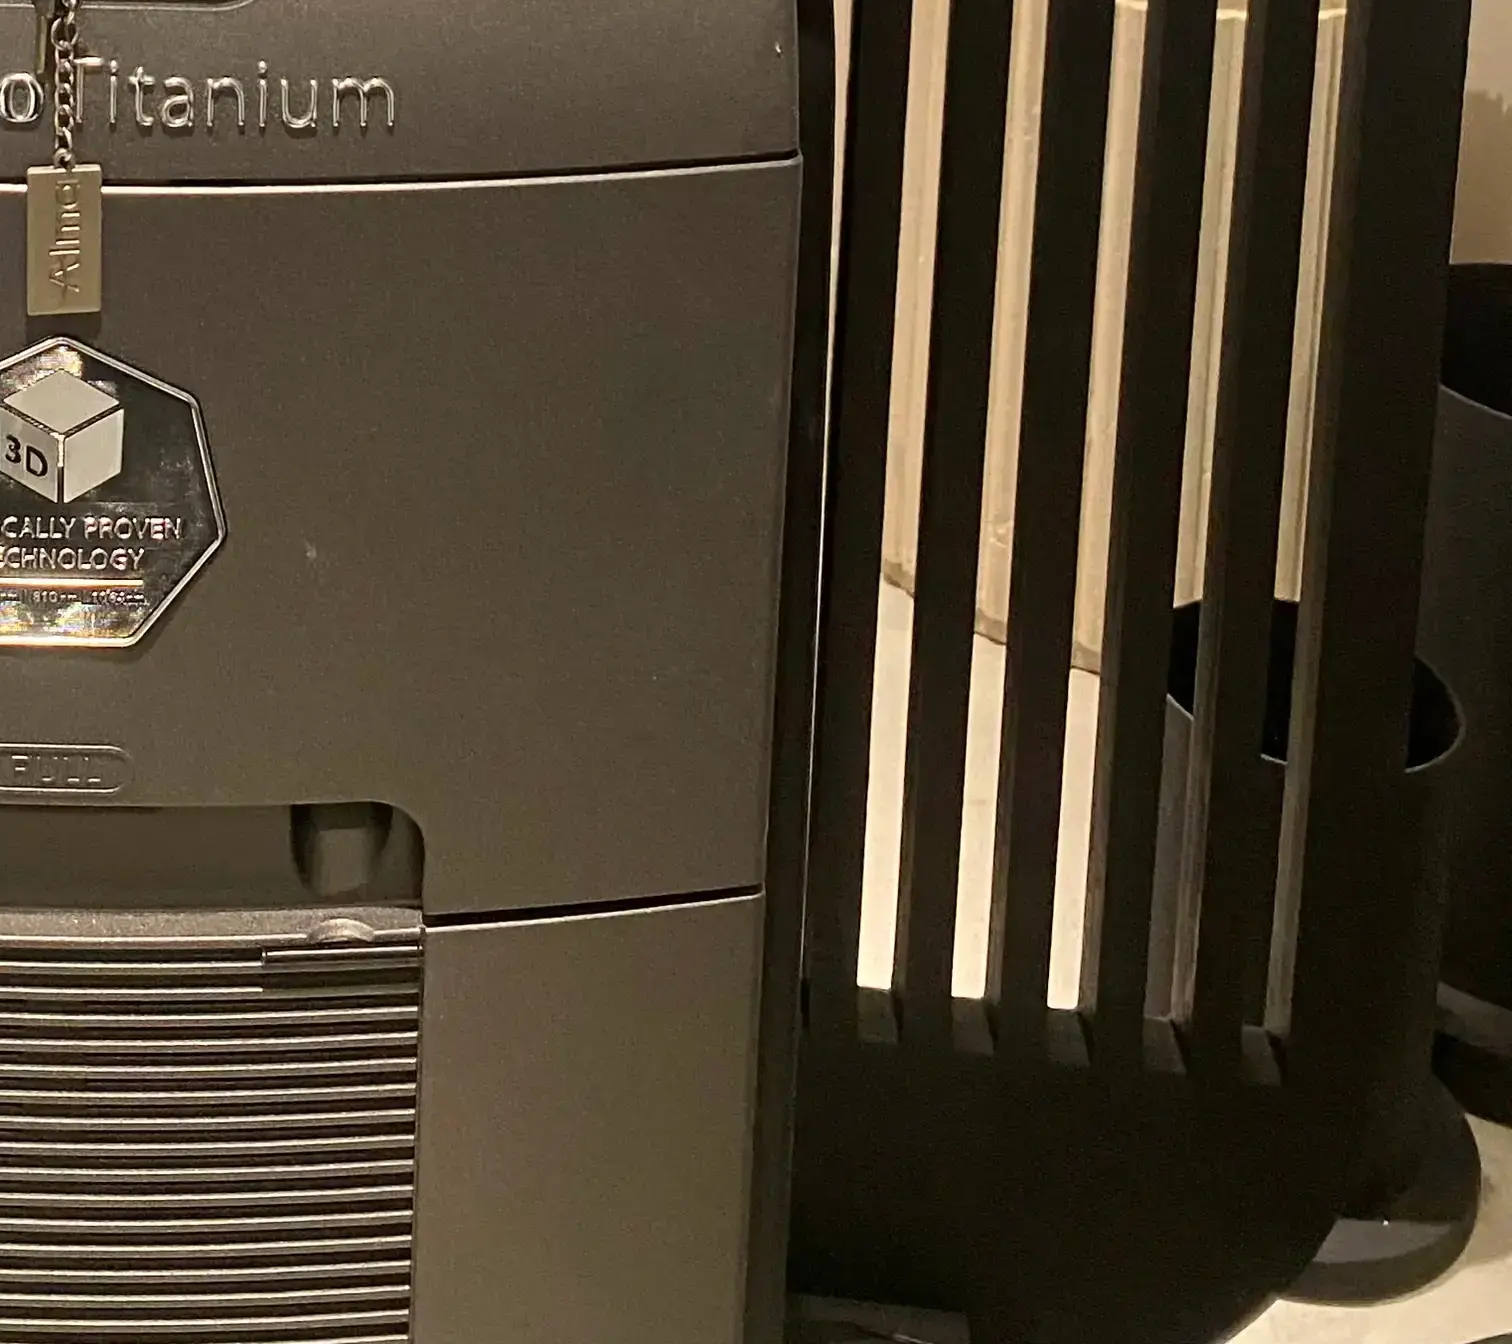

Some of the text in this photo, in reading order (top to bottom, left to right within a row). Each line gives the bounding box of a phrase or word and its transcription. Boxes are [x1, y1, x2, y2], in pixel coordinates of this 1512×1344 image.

[73, 56, 396, 129] Titanium
[4, 433, 49, 478] 3D
[83, 516, 182, 540] PROVEN
